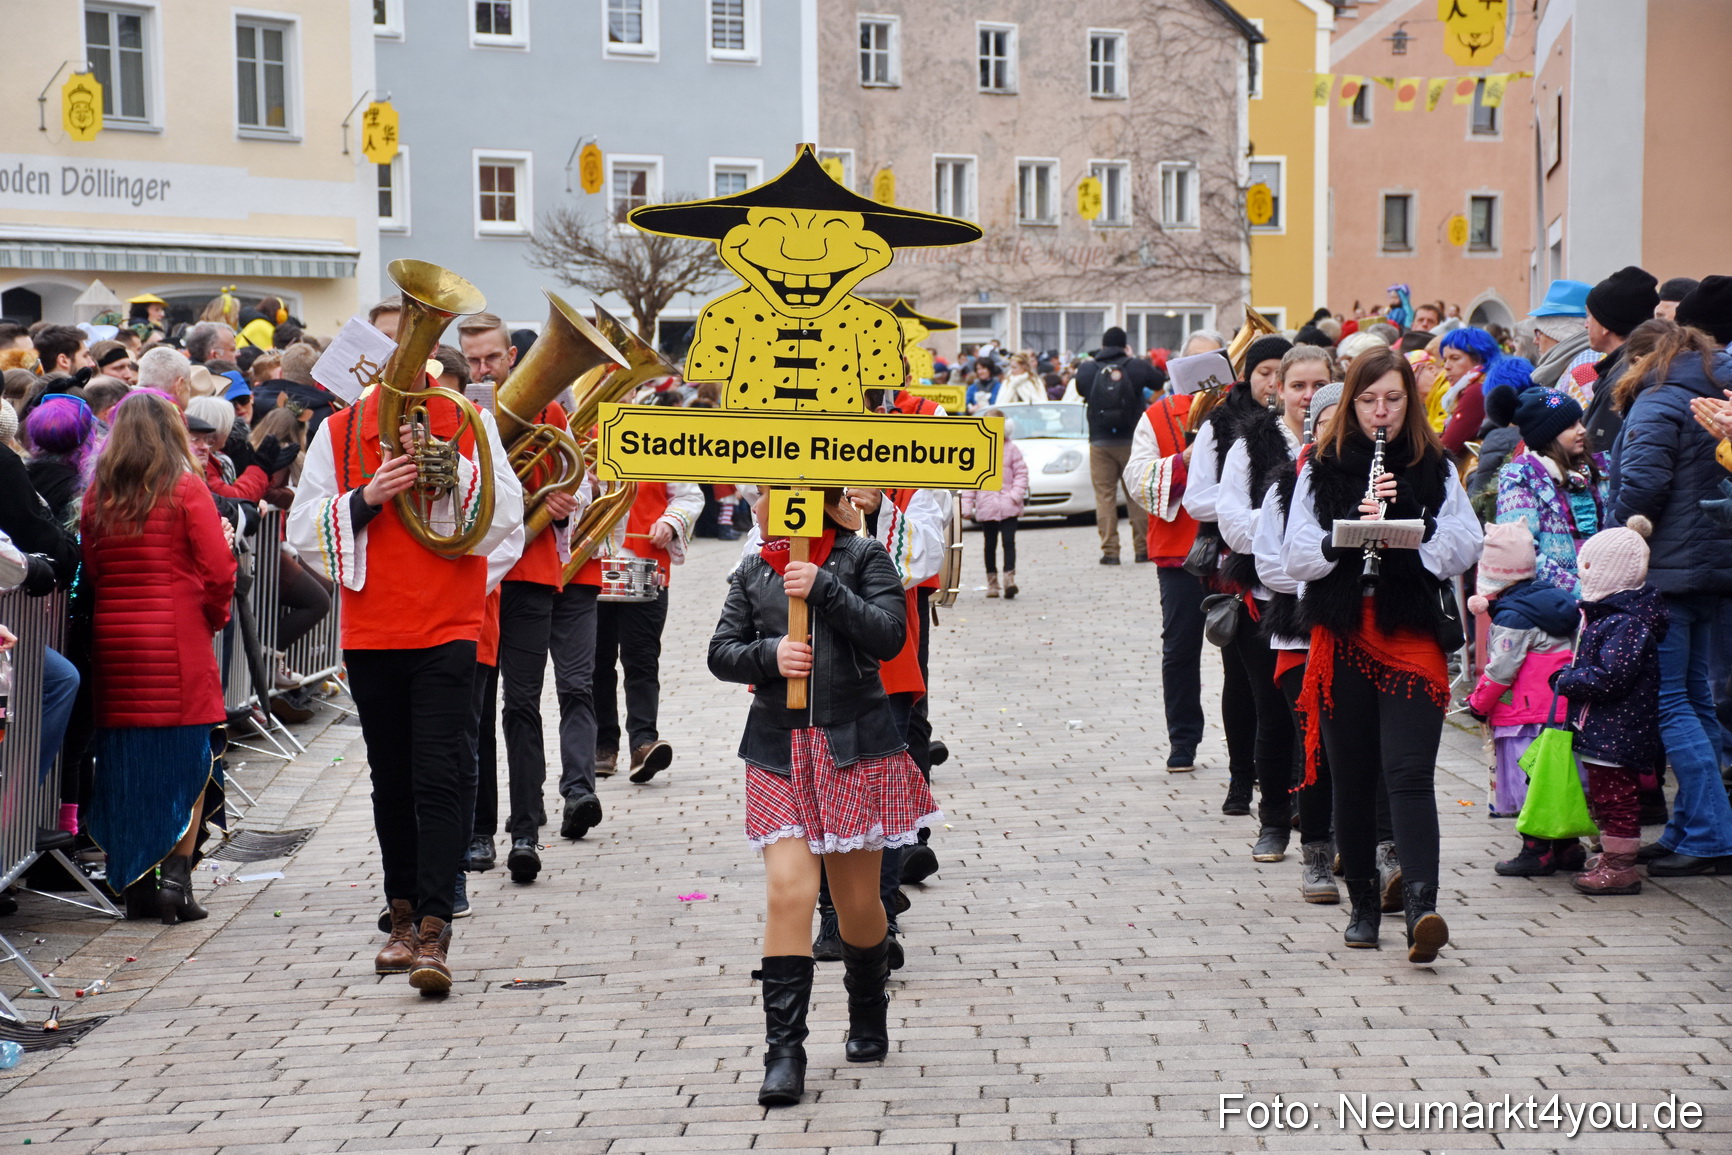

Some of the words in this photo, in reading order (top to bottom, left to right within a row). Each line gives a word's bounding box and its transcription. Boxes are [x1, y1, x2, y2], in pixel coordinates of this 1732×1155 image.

[61, 165, 170, 207] Döllinger
[620, 430, 800, 463] Stadtkapelle
[810, 437, 976, 471] Riedenburg
[783, 497, 807, 530] 5
